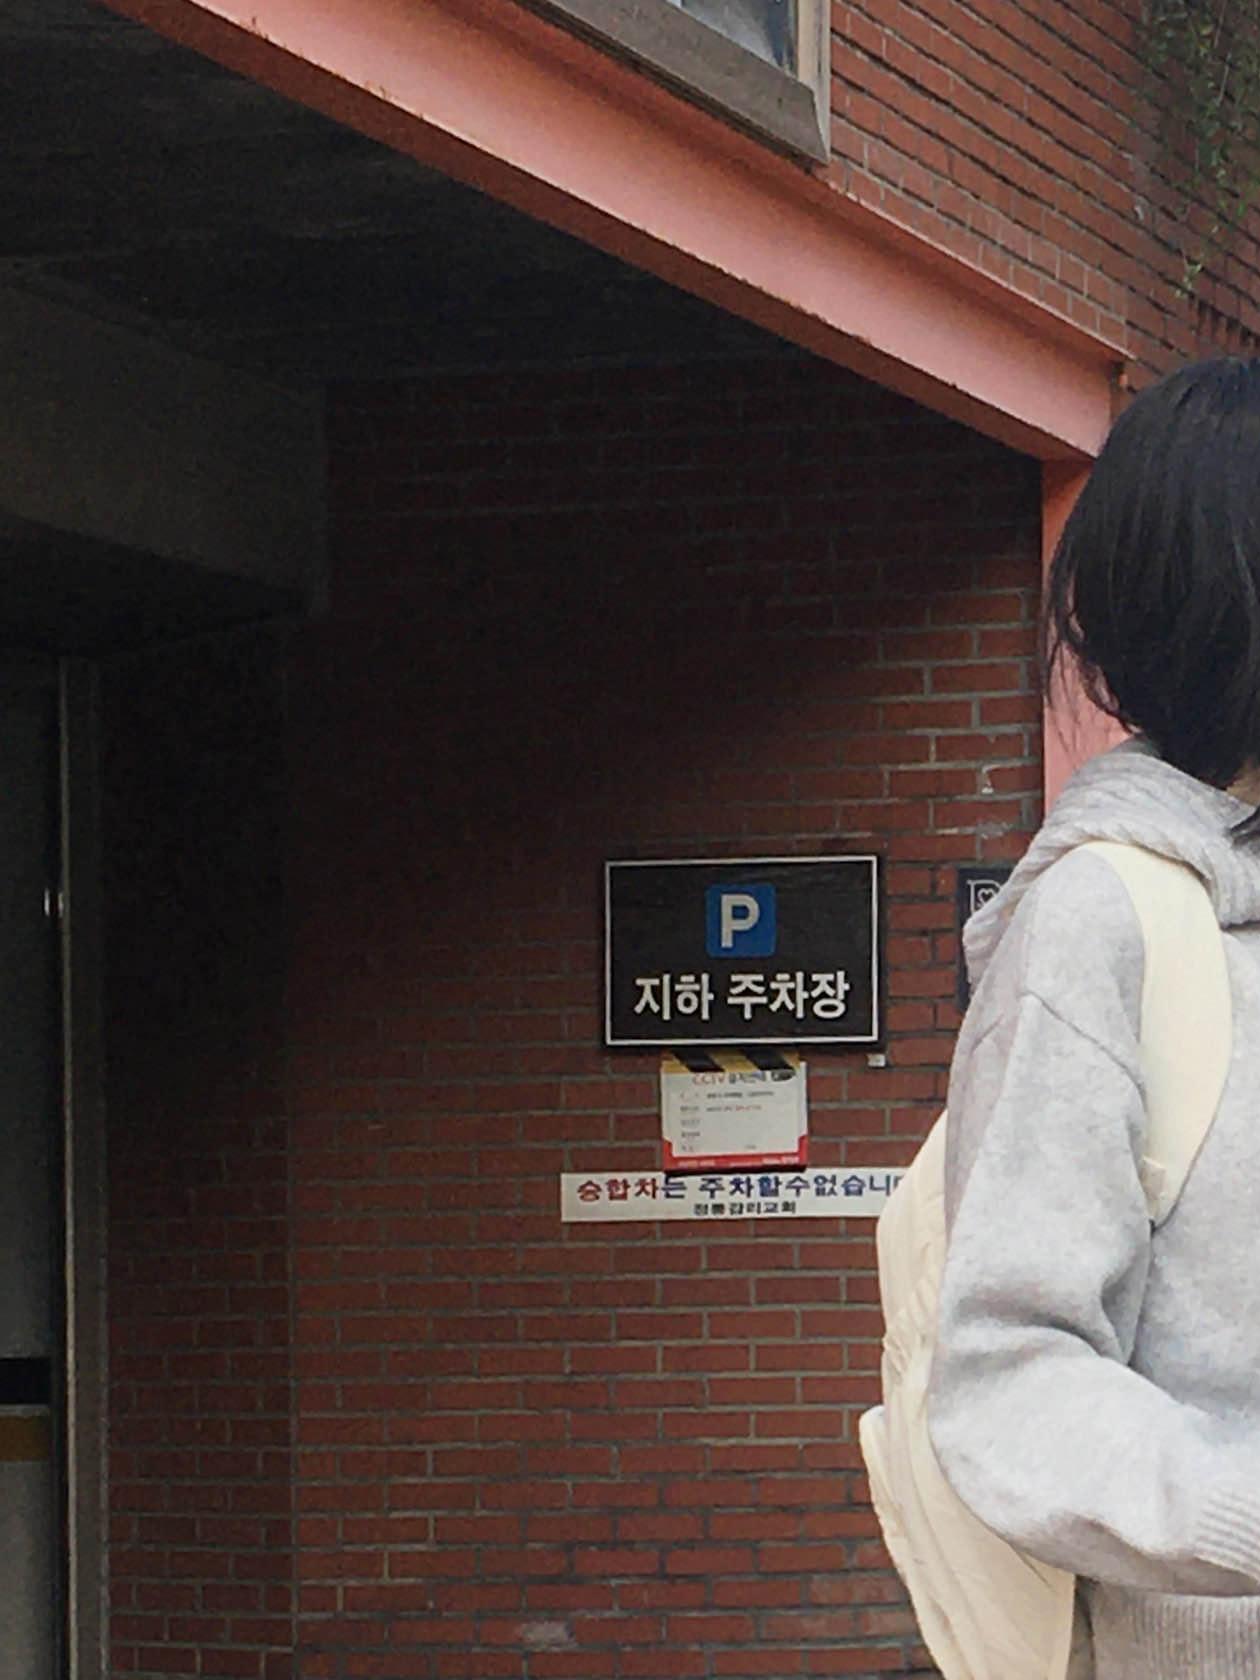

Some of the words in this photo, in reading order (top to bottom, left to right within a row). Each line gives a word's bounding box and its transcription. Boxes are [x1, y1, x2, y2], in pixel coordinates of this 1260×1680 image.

[719, 893, 761, 949] P
[634, 971, 714, 1021] 지하
[726, 970, 851, 1020] 주차장
[577, 1175, 688, 1201] 승합차는
